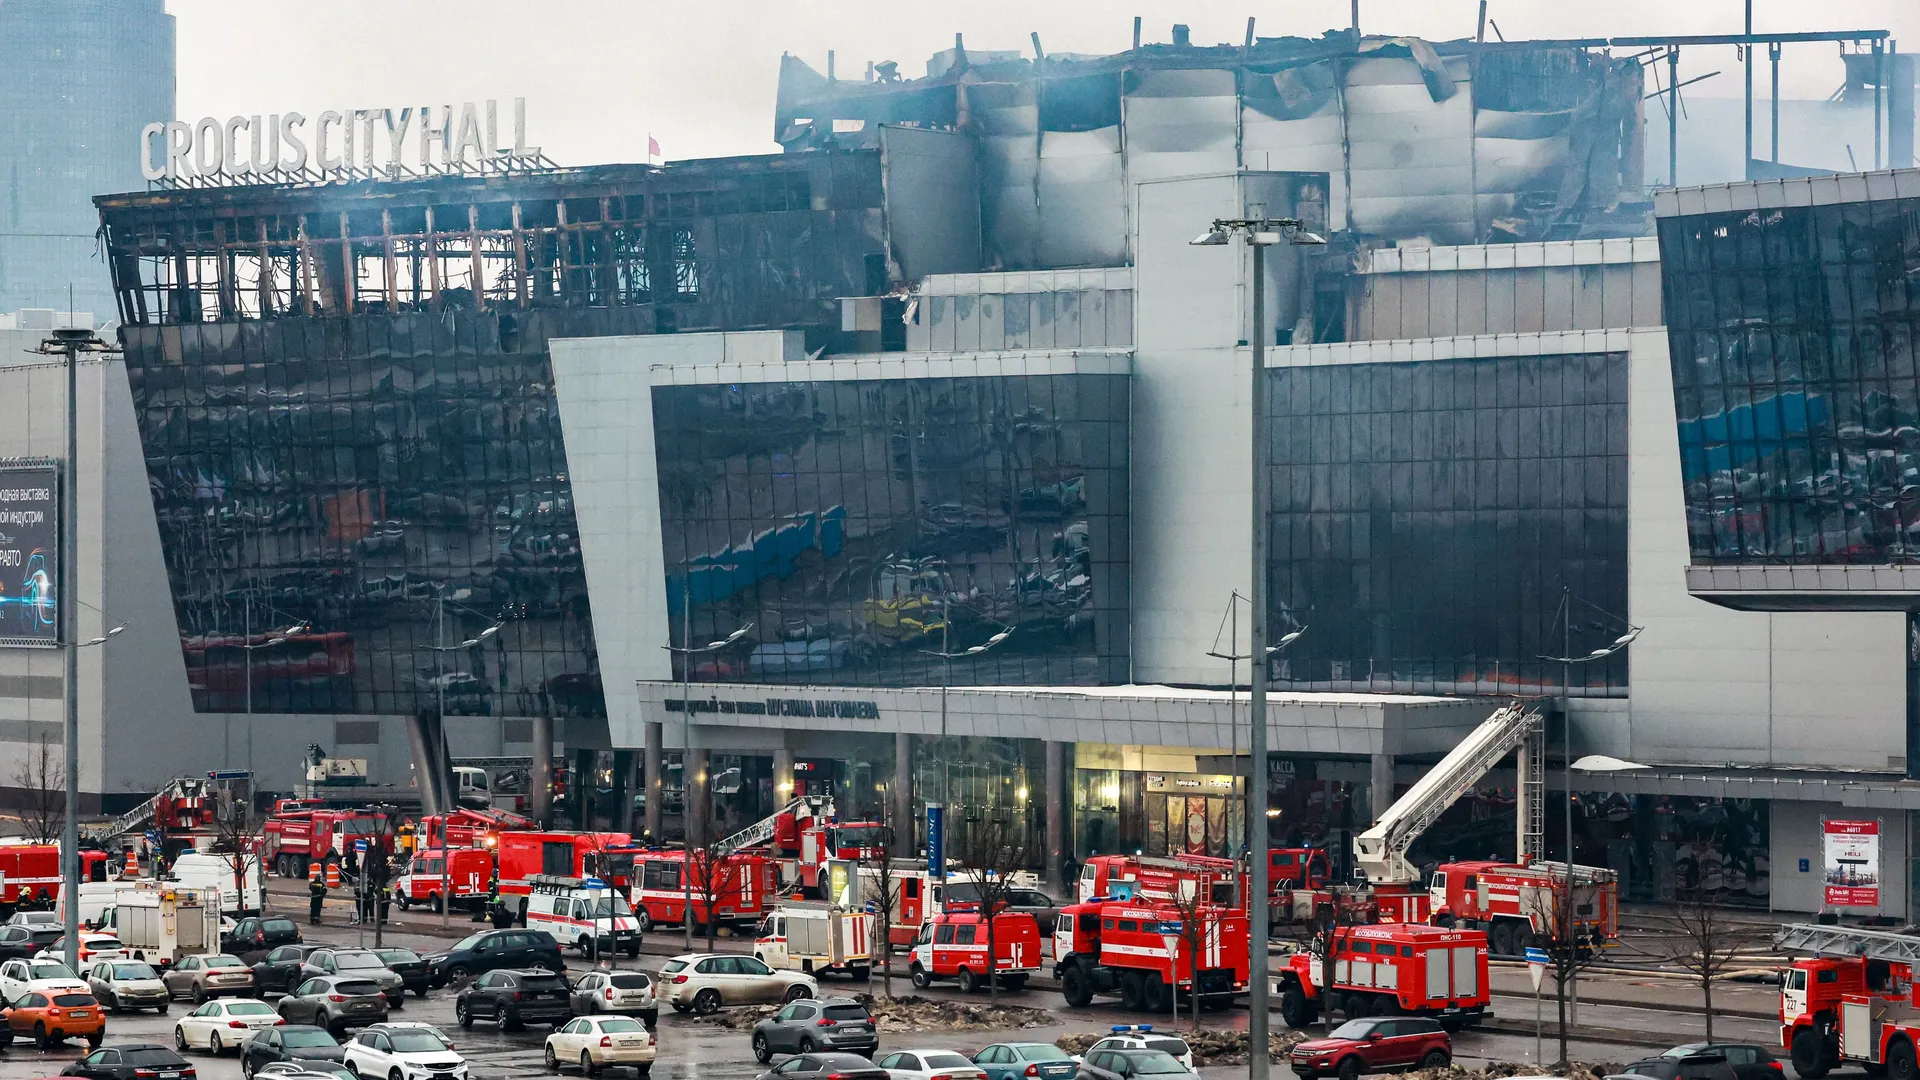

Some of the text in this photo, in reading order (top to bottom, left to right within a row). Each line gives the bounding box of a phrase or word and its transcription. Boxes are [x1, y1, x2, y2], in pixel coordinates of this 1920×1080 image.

[141, 97, 541, 180] CROCUS CITY HALL
[0, 488, 49, 503] одная выставка
[10, 511, 43, 527] индустрии
[815, 700, 881, 720] МАГОМАЕВА
[1270, 761, 1296, 774] КАССА
[1786, 999, 1798, 1010] 227
